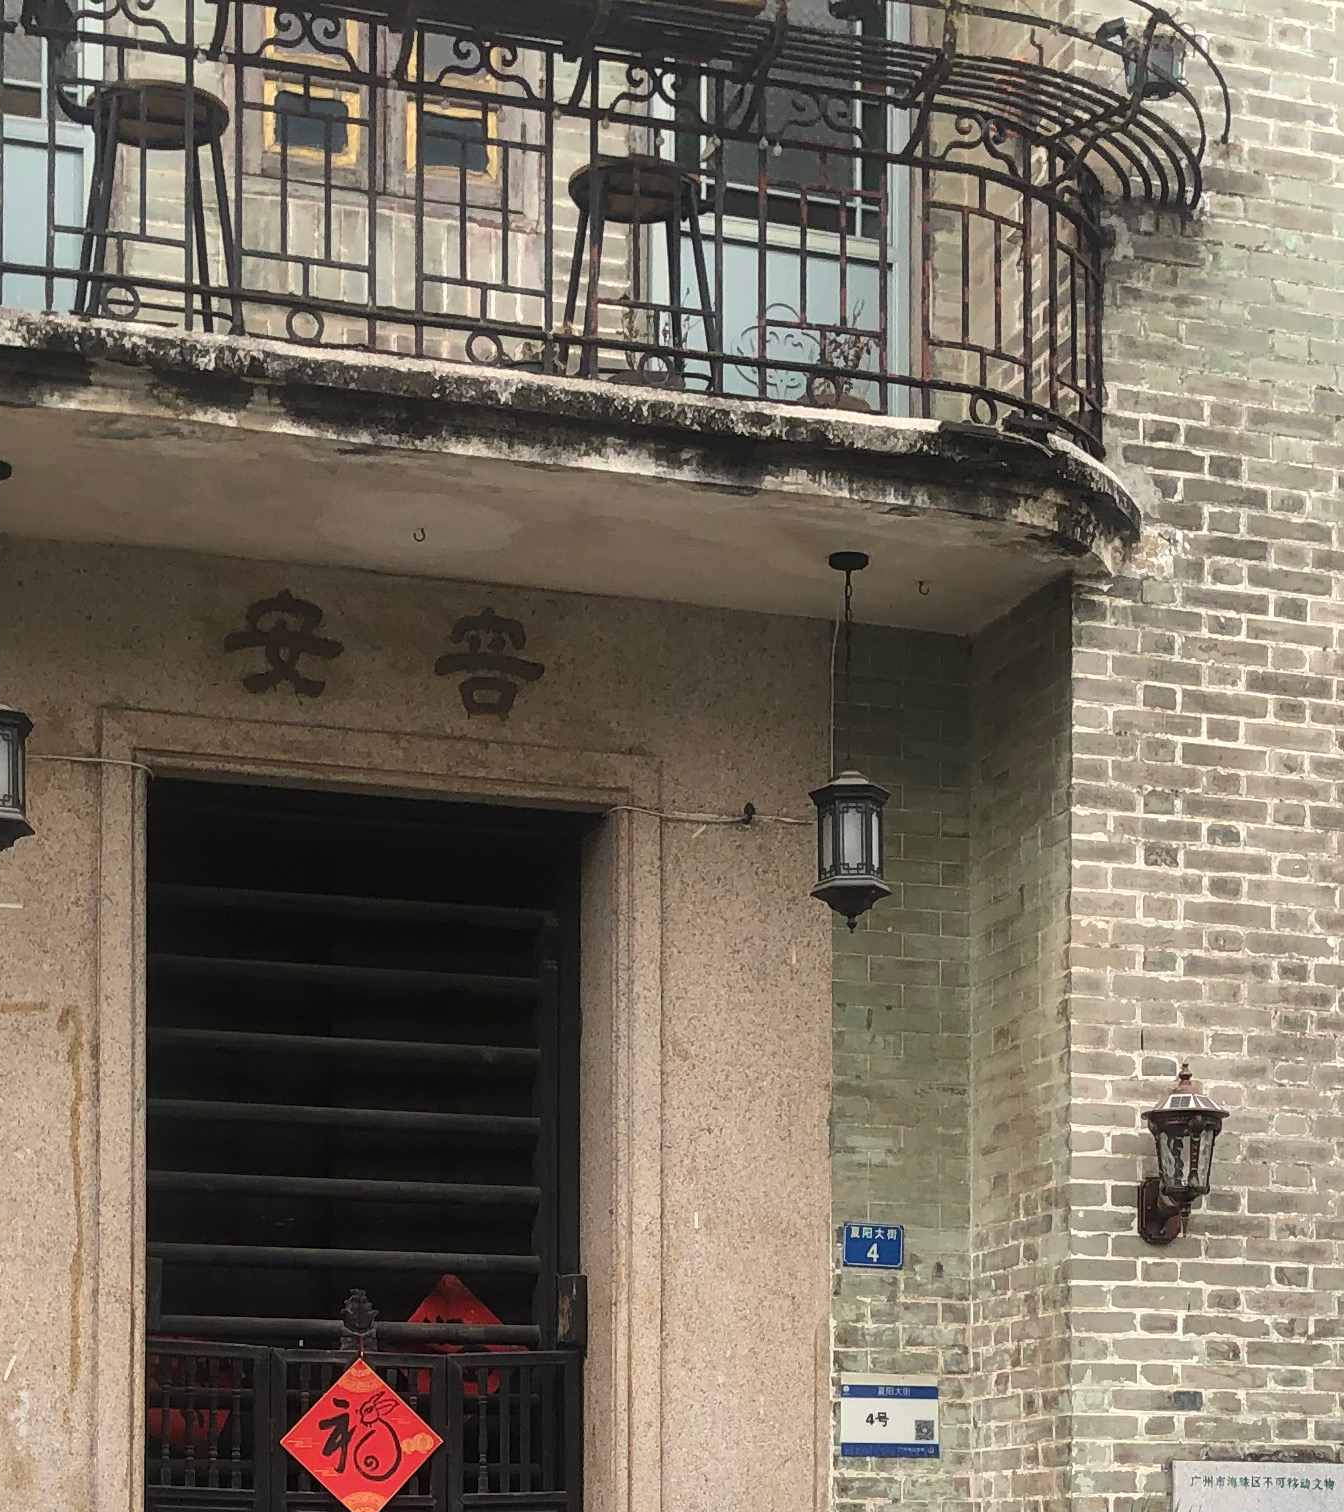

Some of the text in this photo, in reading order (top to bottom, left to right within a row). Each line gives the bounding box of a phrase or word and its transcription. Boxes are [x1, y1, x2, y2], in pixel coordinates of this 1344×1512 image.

[850, 1226, 898, 1240] 夏阳大街
[866, 1243, 880, 1263] 4
[877, 1386, 911, 1397] 夏阳大街
[865, 1411, 890, 1428] 4号
[1190, 1475, 1337, 1491] 广州市海珠区不可移动文物
